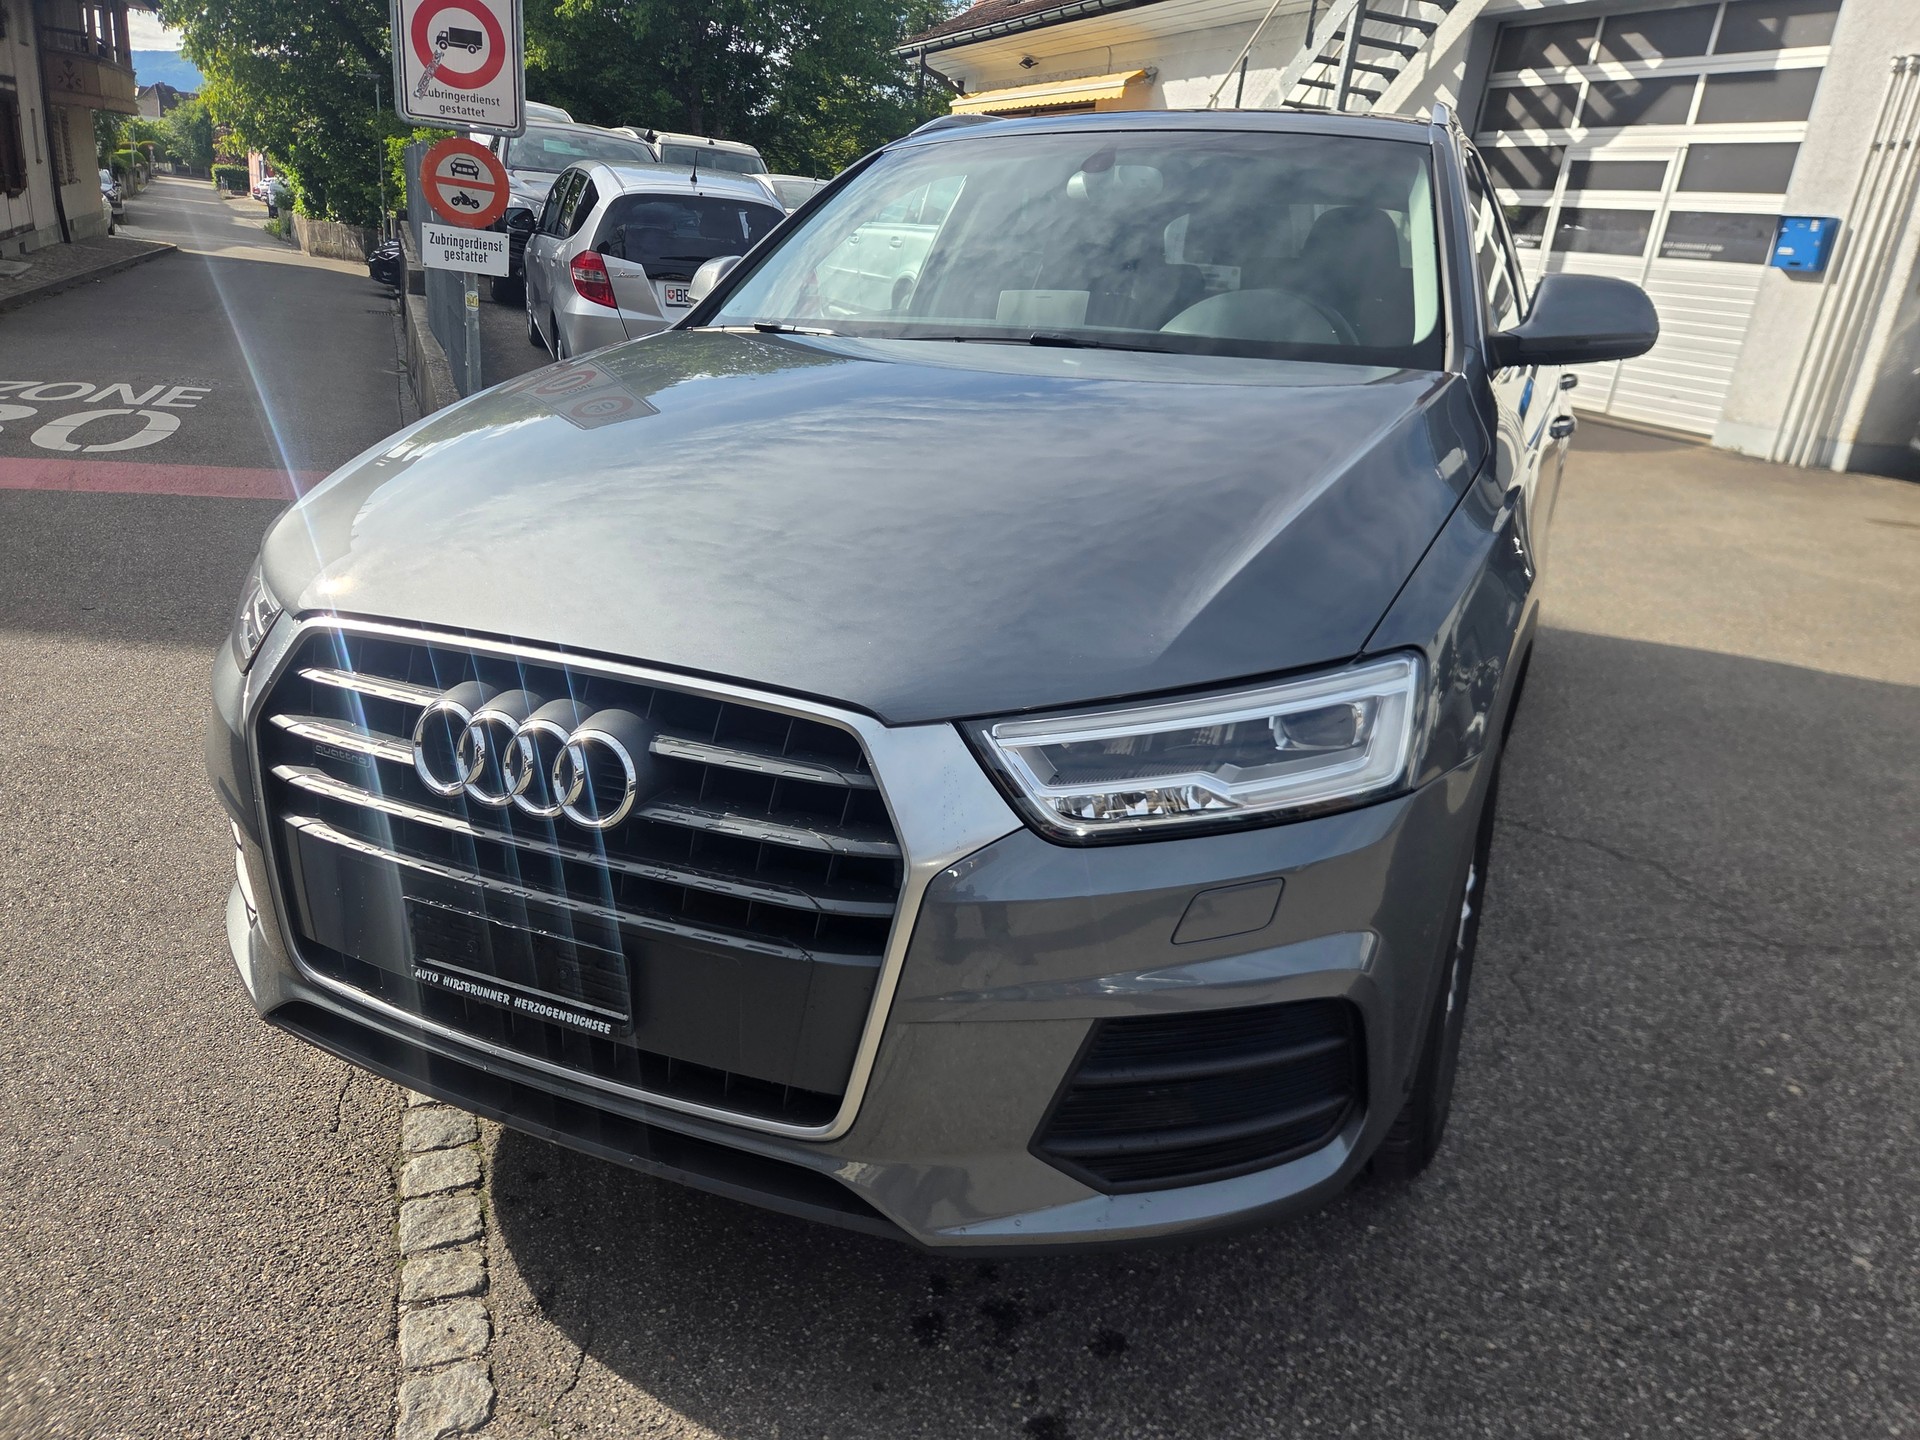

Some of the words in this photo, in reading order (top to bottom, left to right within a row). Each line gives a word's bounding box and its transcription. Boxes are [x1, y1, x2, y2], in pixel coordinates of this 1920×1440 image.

[423, 87, 500, 107] ubringerdienst
[439, 104, 486, 118] gestattet
[429, 231, 503, 252] Zubringerdienst
[444, 249, 488, 263] gestattet
[315, 743, 368, 764] quattro
[414, 968, 439, 984] AUTO
[443, 976, 510, 1005] HIRSBRUNNER
[513, 997, 612, 1035] HERZOGENBUCHSEE
